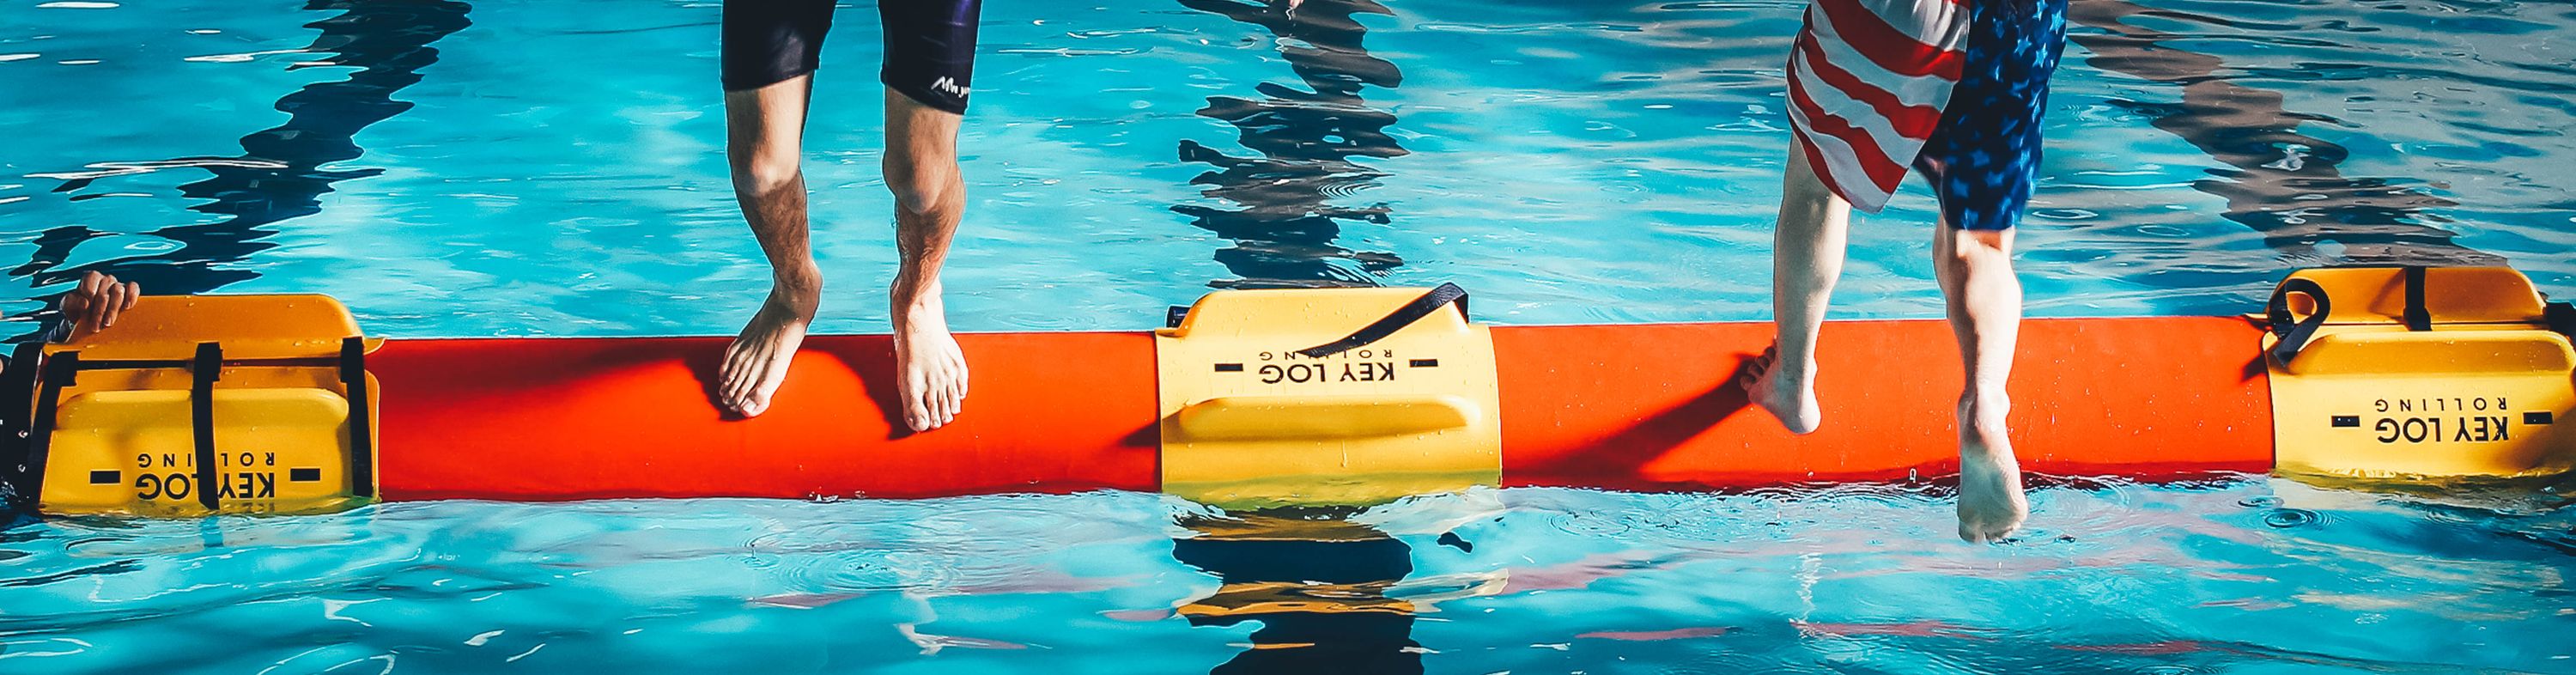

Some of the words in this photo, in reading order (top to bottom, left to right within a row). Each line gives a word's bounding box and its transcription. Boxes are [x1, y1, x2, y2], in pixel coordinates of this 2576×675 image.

[1259, 363, 1326, 385] LOG
[1340, 362, 1395, 383] KEY
[2375, 398, 2507, 412] ROLLING
[2375, 417, 2441, 443] LOG
[2454, 417, 2510, 442] KEY
[137, 452, 275, 468] ROLING
[136, 473, 198, 500] OG
[219, 473, 275, 499] KEY
